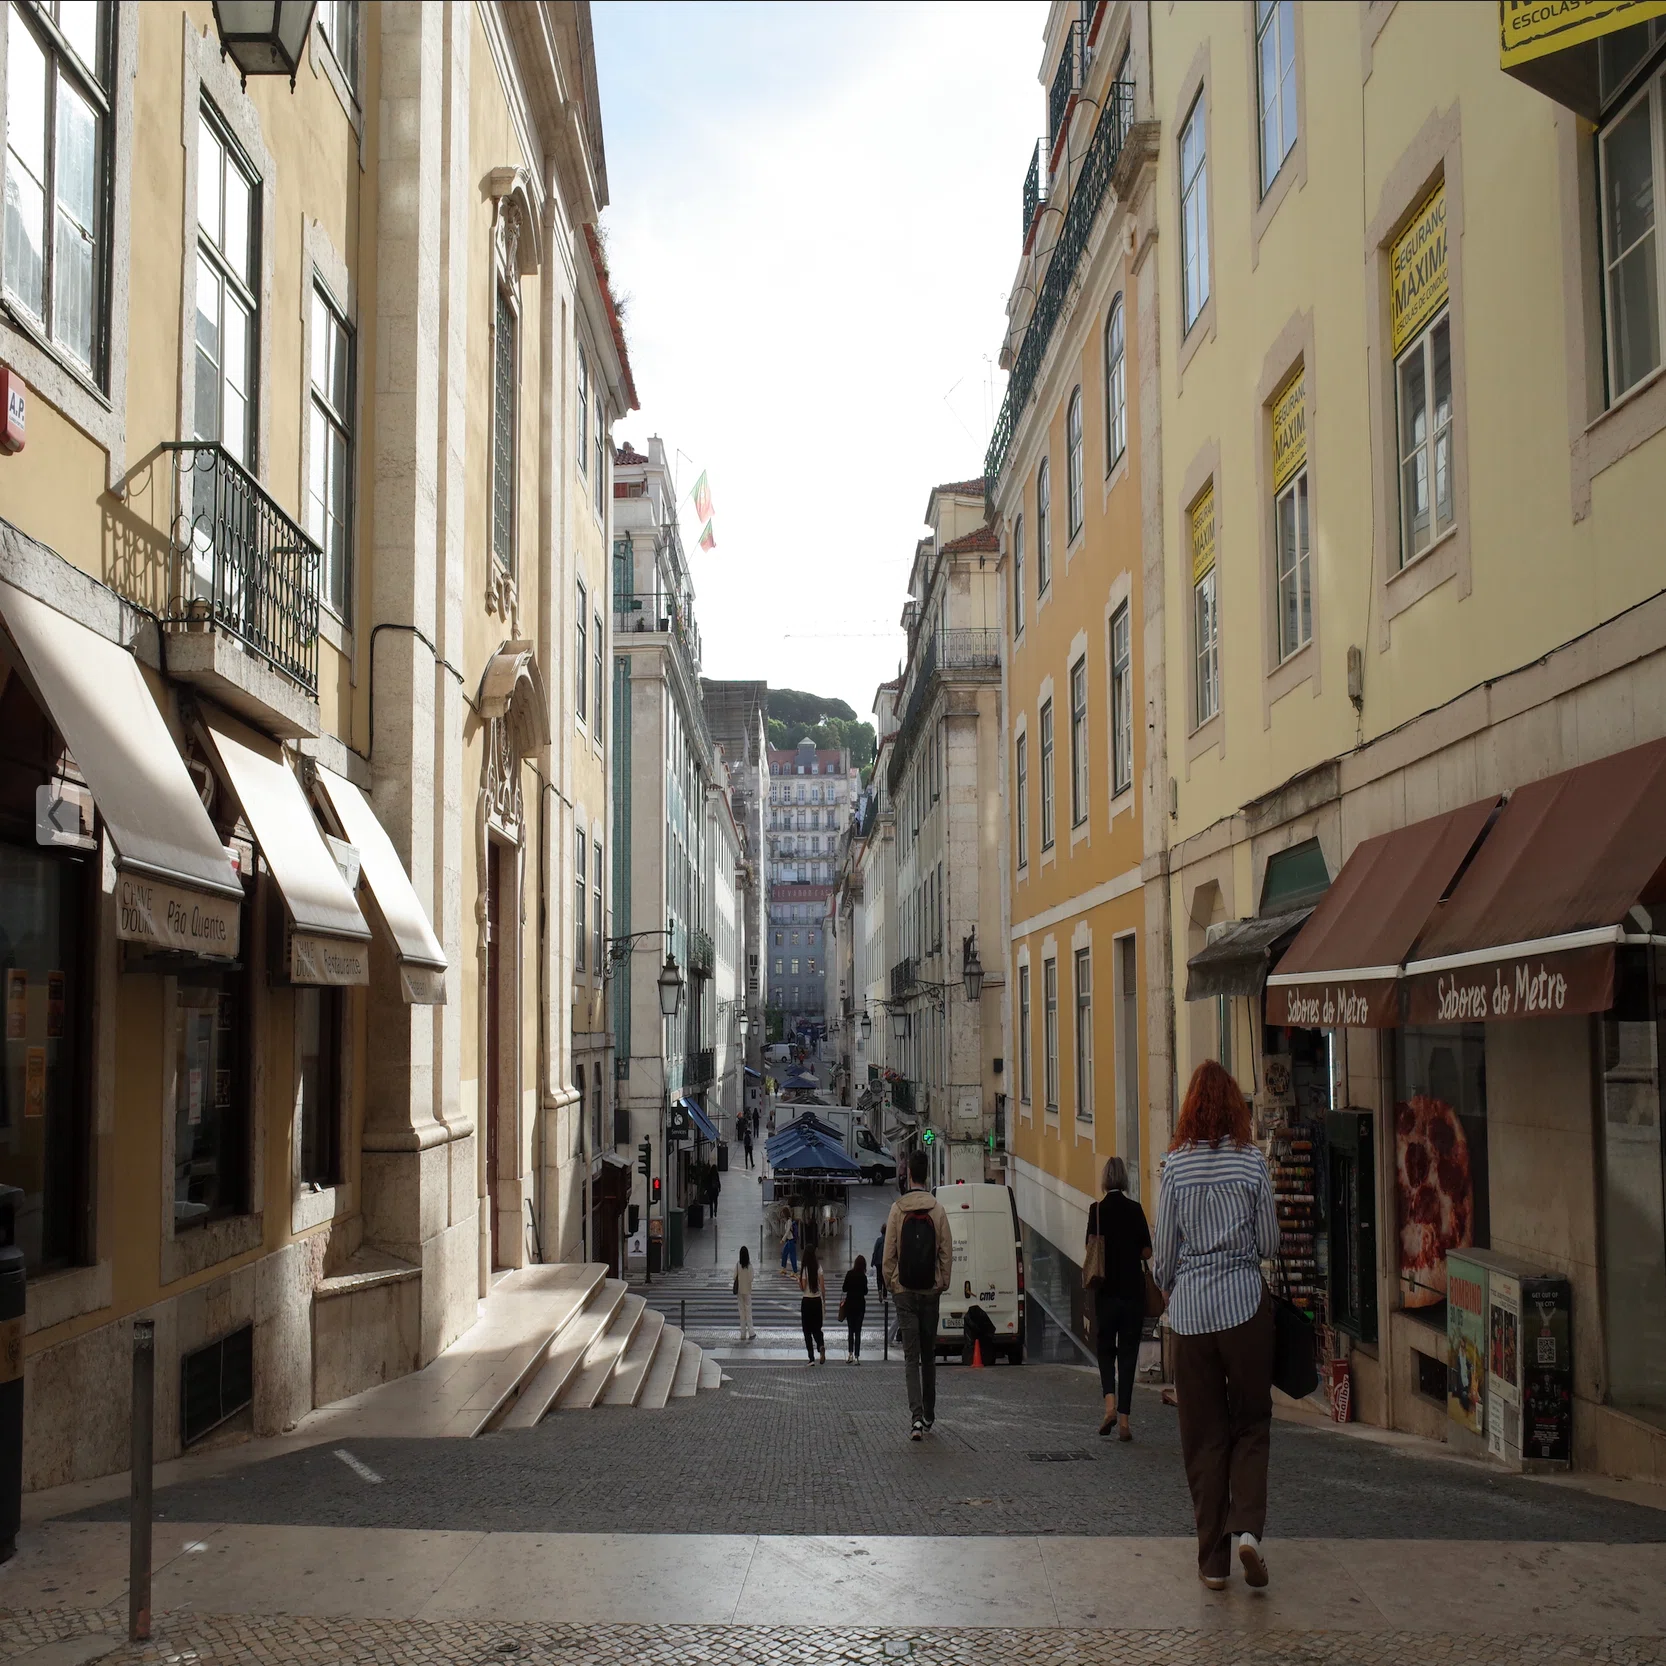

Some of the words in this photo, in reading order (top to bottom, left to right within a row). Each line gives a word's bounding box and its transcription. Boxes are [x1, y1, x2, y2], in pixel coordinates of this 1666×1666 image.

[1512, 1, 1580, 30] ESCOLAS
[1396, 302, 1418, 334] ESCOLAS
[1418, 294, 1426, 311] DE
[9, 392, 25, 421] A.P.
[167, 900, 187, 934] Pão
[191, 905, 226, 941] Quente
[324, 948, 361, 975] Restaurante
[1287, 987, 1319, 1023] Sabores
[1323, 988, 1335, 1022] do
[1337, 987, 1369, 1024] Metro
[1438, 974, 1487, 1020] Sabores
[1492, 968, 1511, 1015] do
[1513, 963, 1568, 1013] Metro
[979, 1291, 996, 1302] cme
[1339, 1376, 1349, 1421] mailbox
